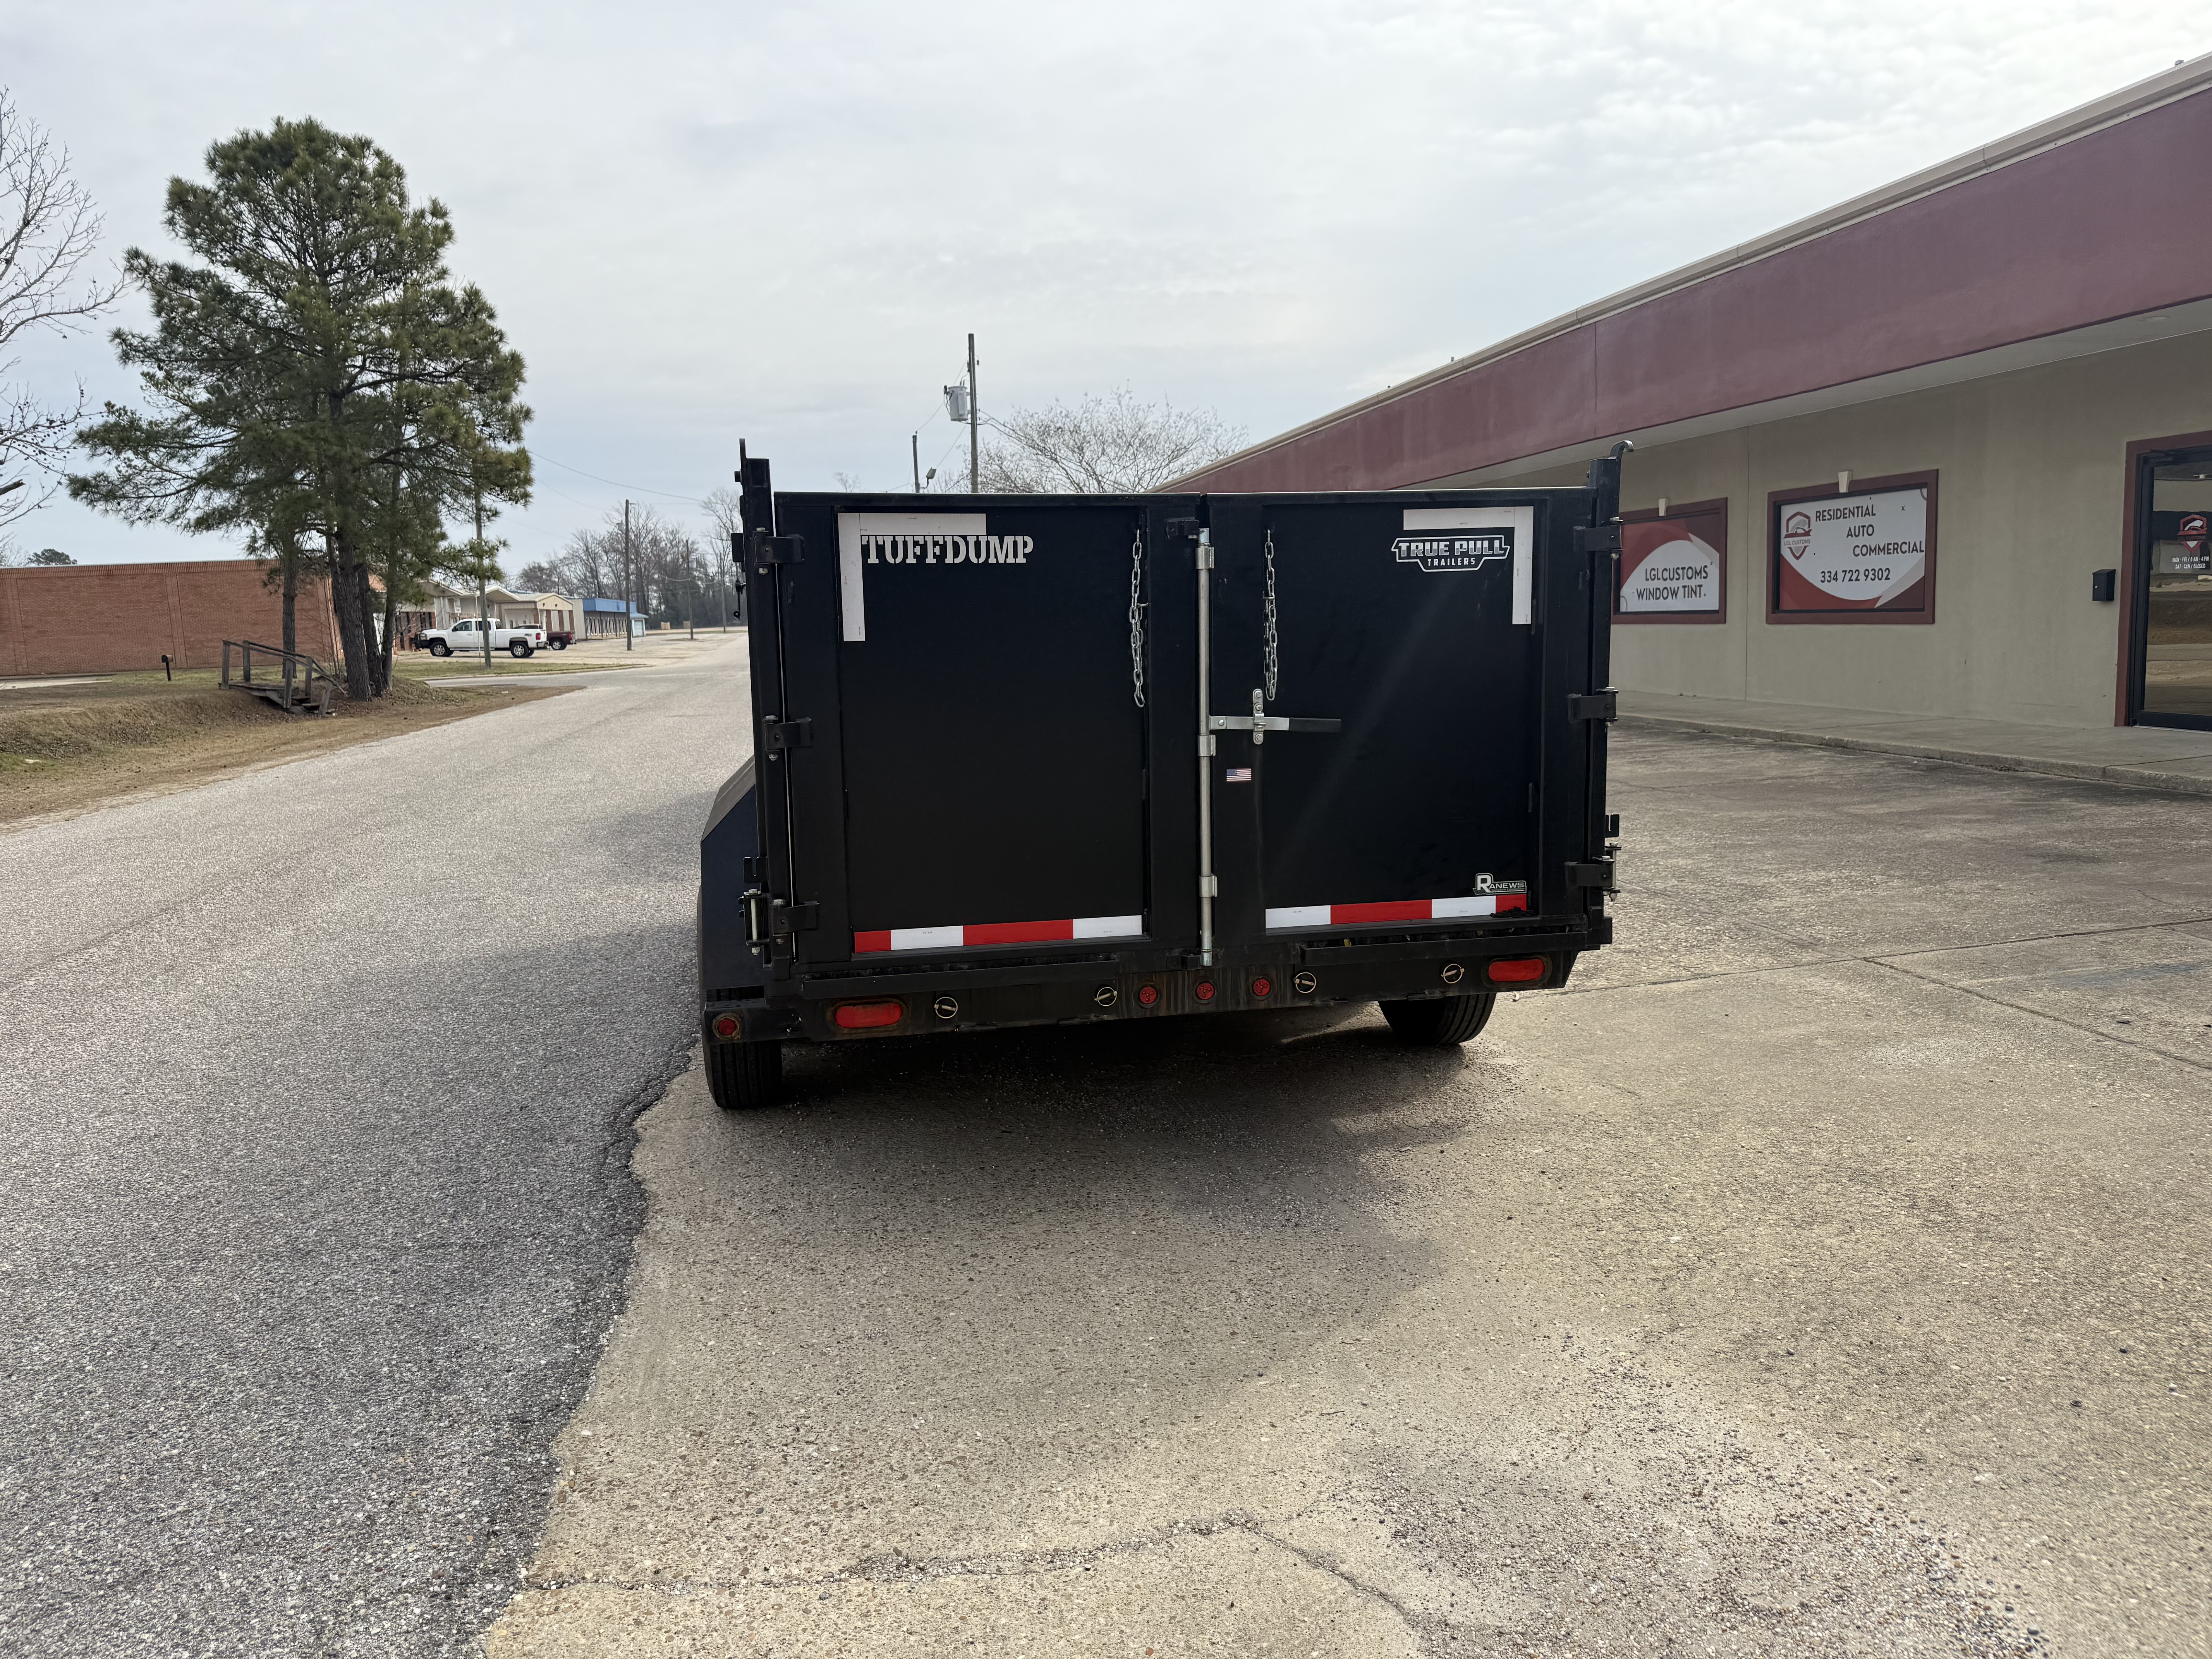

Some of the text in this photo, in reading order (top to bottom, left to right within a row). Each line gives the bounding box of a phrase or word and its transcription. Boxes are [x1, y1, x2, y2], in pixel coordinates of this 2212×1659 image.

[1815, 504, 1876, 522] RESIDENTIAL
[1846, 524, 1874, 538] AUTO
[862, 536, 1034, 563] TUFFDUMP
[1398, 540, 1504, 557] TRUE PULL
[1853, 540, 1924, 557] COMMERCIAL
[1427, 558, 1475, 567] TRAILERS
[1820, 568, 1890, 583] 334 722 9302
[1636, 584, 1703, 601] WINDOW TINT
[1477, 874, 1525, 893] RANEWS
